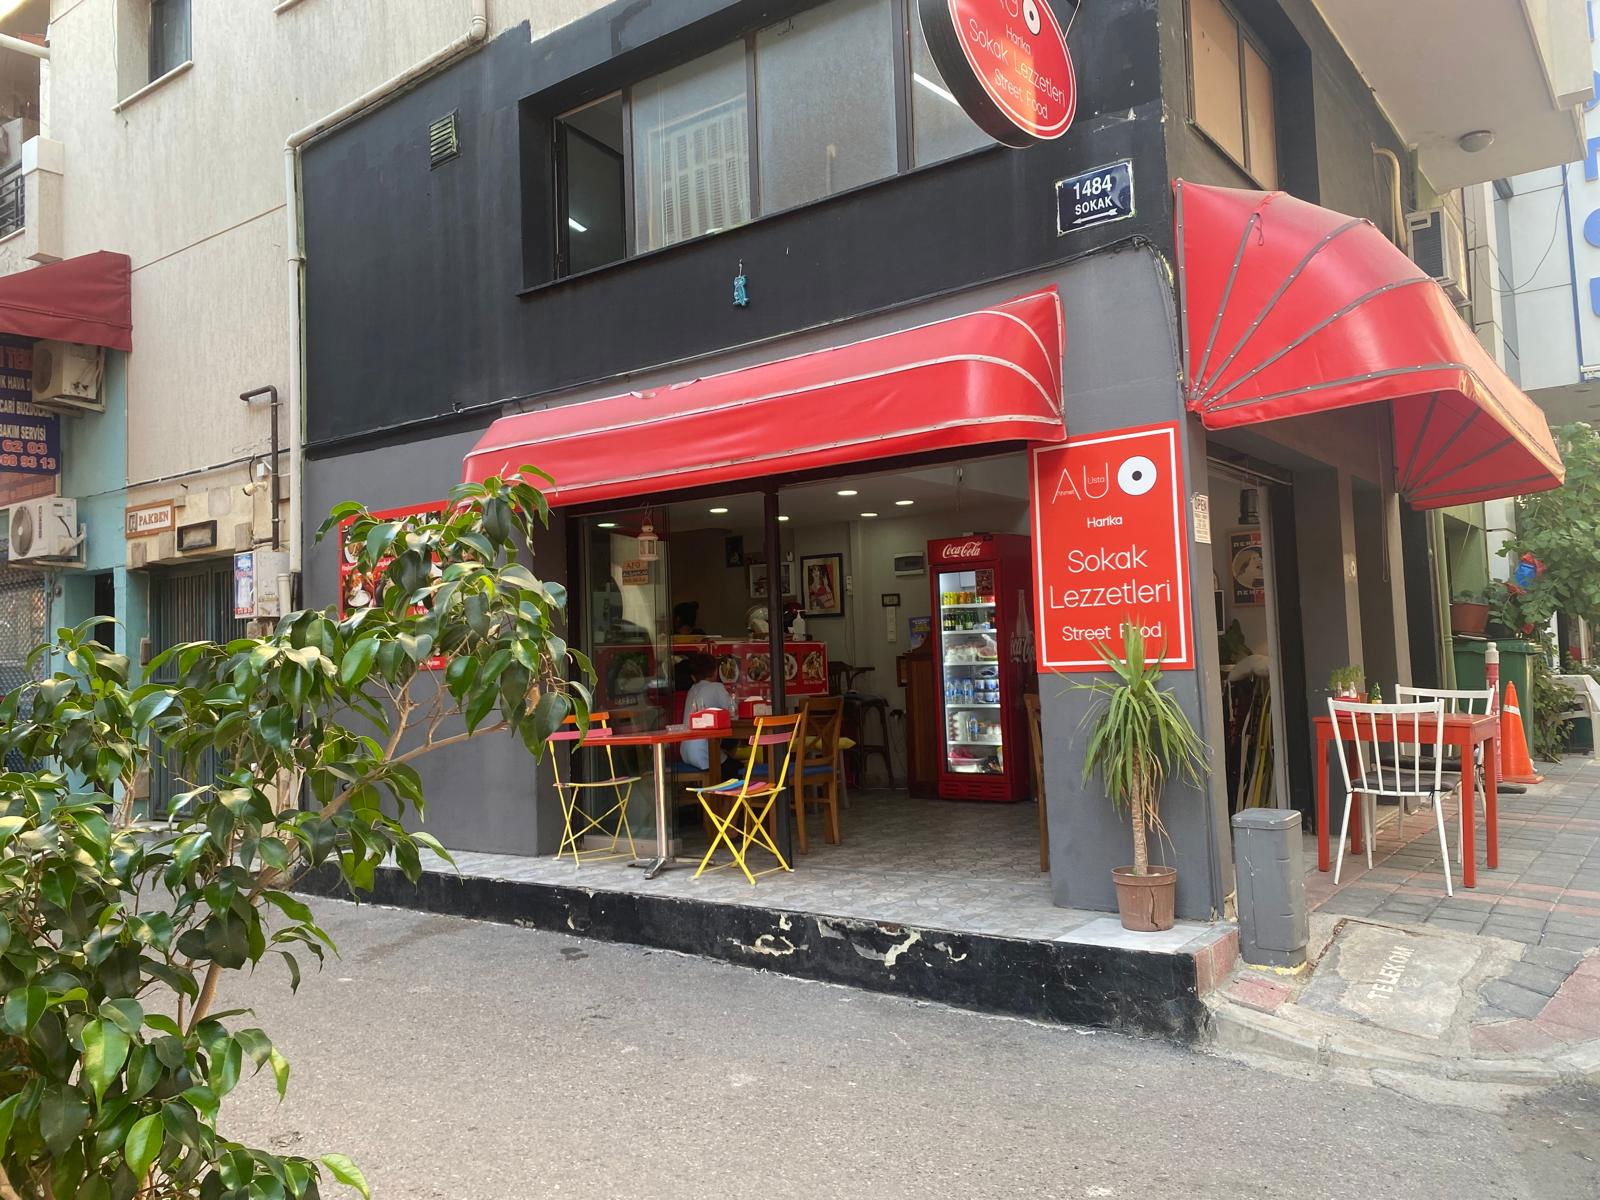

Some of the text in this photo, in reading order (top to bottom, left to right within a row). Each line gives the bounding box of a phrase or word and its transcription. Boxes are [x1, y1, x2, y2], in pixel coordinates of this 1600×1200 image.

[969, 19, 1066, 107] Sokak Lezzetleri
[994, 68, 1048, 119] Street Food
[1073, 175, 1112, 200] 1484
[1075, 196, 1113, 215] SOKAK
[8, 376, 25, 391] HAVA
[21, 424, 46, 441] SERVİSİ
[1086, 515, 1123, 529] Harika
[1068, 544, 1148, 574] Sokak
[1049, 579, 1171, 609] Lezzetleri
[1062, 621, 1162, 641] Street Fod
